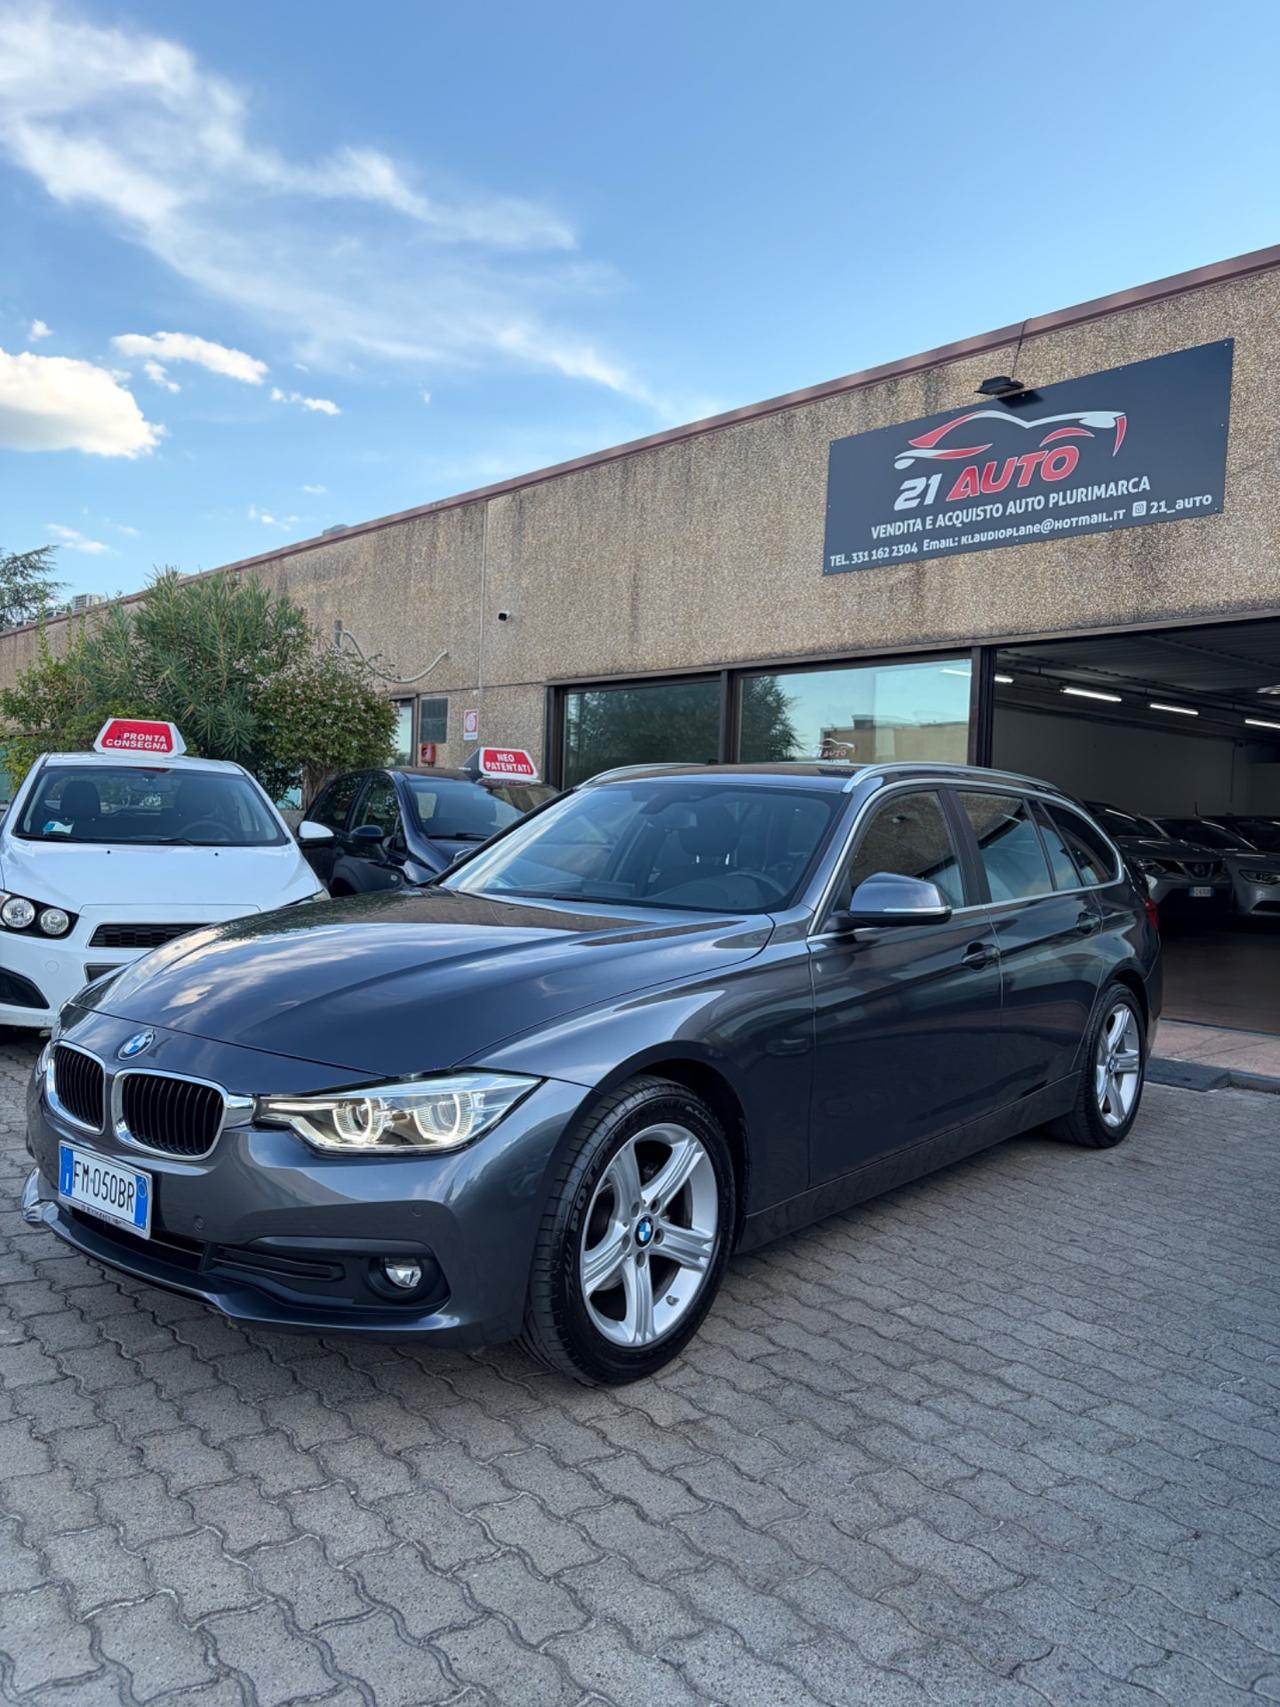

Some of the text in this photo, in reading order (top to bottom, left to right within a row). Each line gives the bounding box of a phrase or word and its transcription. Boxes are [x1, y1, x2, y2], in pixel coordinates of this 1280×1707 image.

[893, 445, 1080, 511] 21 AUTO
[871, 475, 1151, 540] VENDITA E ACQUISTO AUTO PLURIMARCA
[830, 555, 850, 567] TEL.
[851, 551, 870, 564] 331
[871, 547, 890, 561] 162
[891, 543, 918, 557] 2304
[123, 732, 166, 743] PRONTA
[106, 738, 168, 750] CONSEGNA
[496, 753, 515, 762] NEO
[485, 761, 531, 773] PATENTATI
